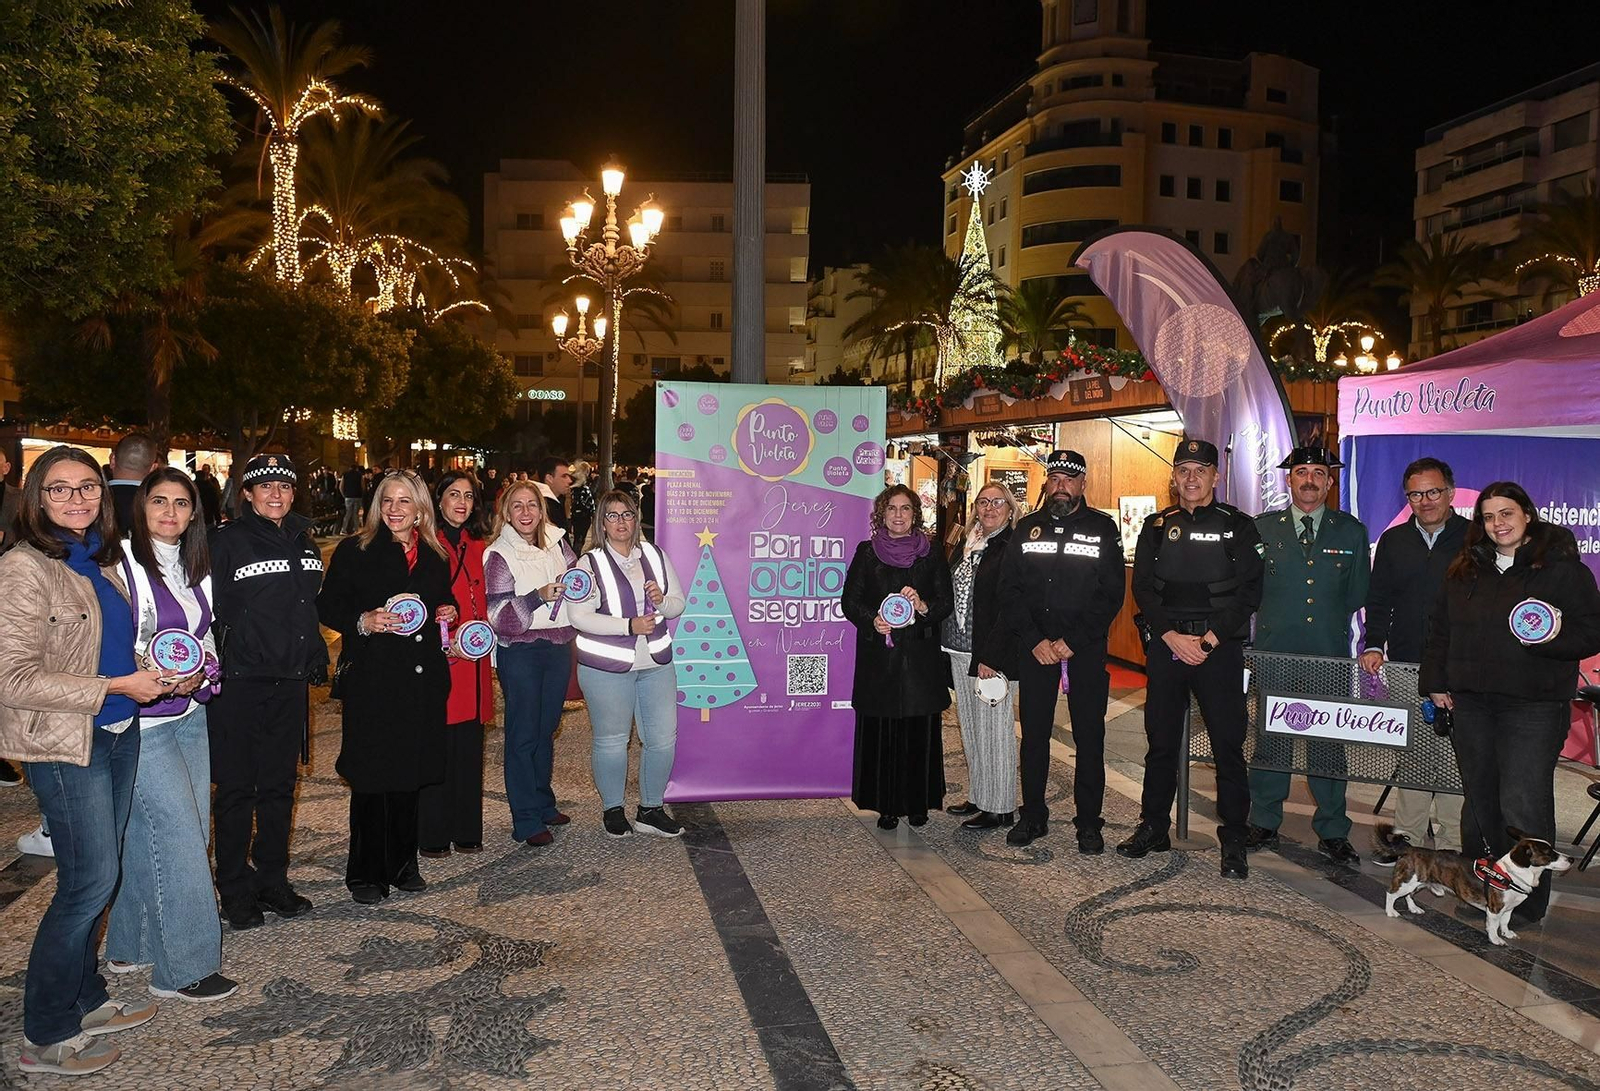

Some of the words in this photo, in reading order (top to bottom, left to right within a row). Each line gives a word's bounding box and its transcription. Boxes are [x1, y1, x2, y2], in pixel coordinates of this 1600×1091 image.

[528, 389, 565, 400] OCASO
[1352, 384, 1414, 424] Punto
[1418, 376, 1497, 415] Violeta
[749, 410, 798, 443] Punto
[748, 443, 797, 465] Violeta
[761, 484, 837, 531] Jerez
[1535, 501, 1600, 526] sistenci
[750, 532, 800, 558] Por
[810, 536, 844, 558] un
[750, 560, 845, 597] ocio
[748, 638, 766, 647] en
[776, 628, 845, 654] Navidad
[1269, 701, 1331, 726] Punto
[1335, 707, 1405, 736] Violeta
